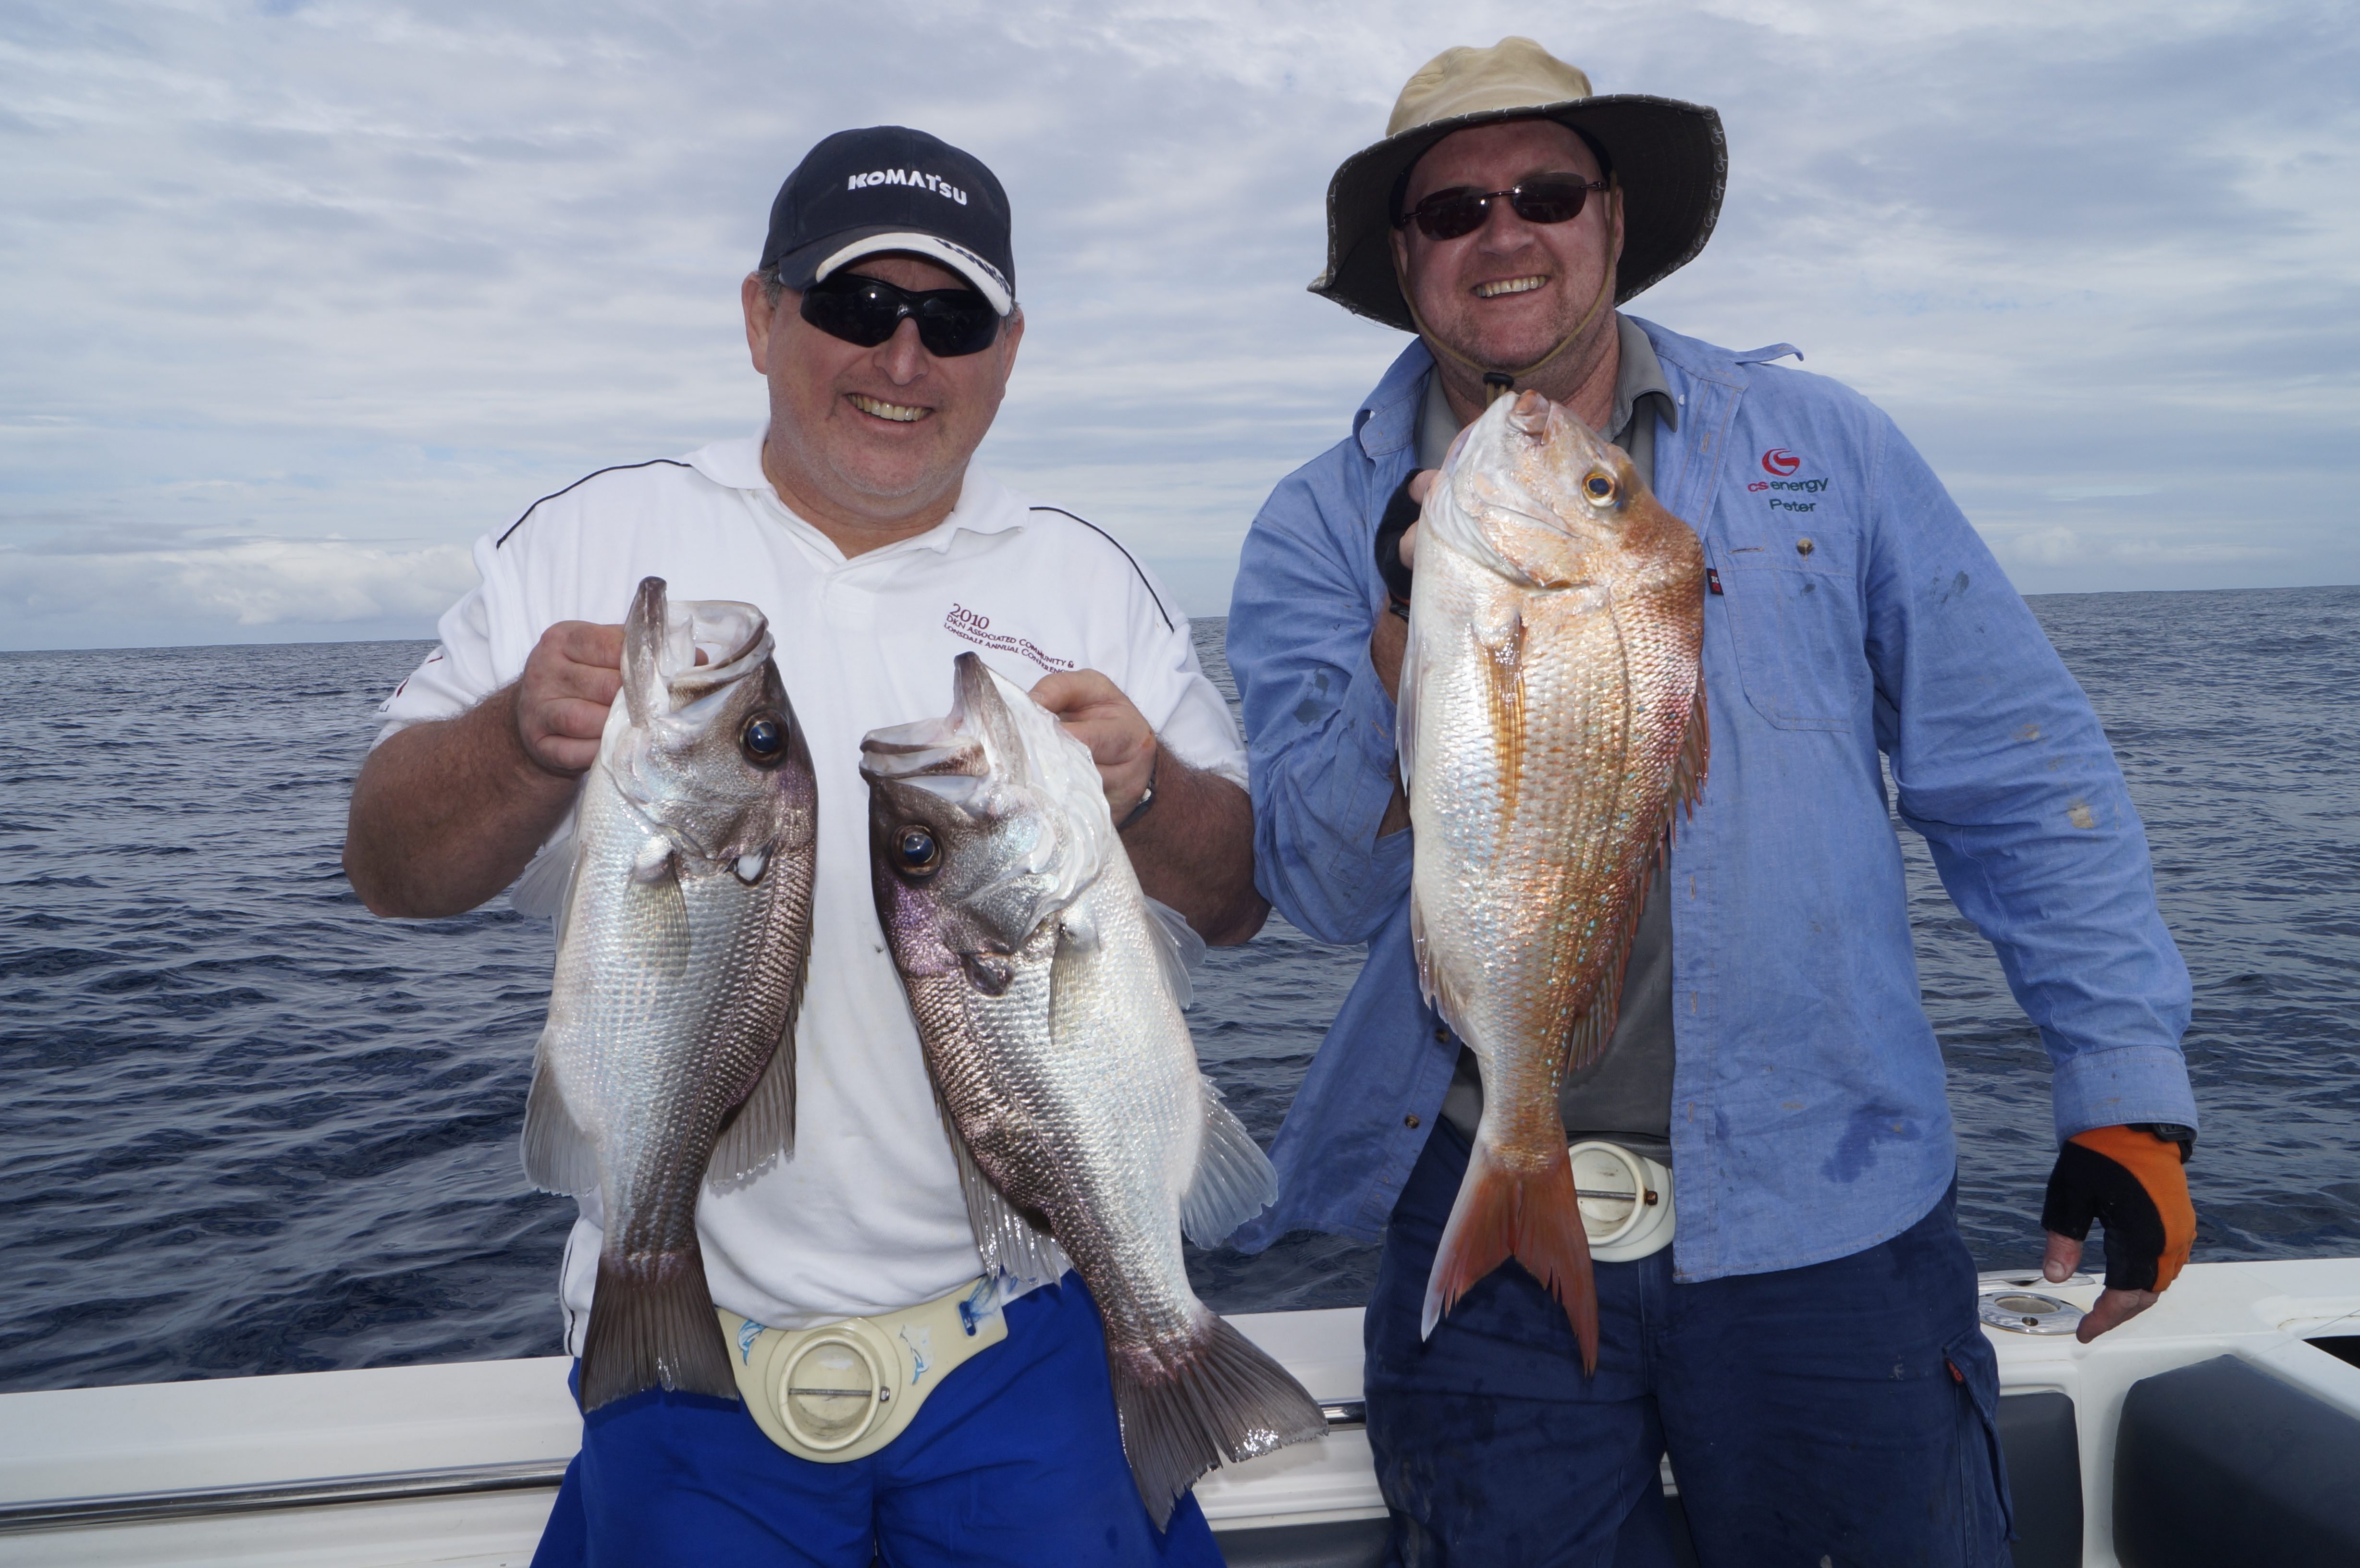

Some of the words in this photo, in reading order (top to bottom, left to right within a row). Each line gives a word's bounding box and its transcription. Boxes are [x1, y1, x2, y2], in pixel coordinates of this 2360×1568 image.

[848, 169, 967, 206] KOMATSU
[1770, 478, 1829, 493] energy
[1769, 499, 1817, 512] Peter
[949, 603, 990, 630] 2010
[944, 622, 983, 645] LONSDALE
[985, 641, 1019, 654] ANNUAL
[946, 614, 966, 629] DKN
[967, 626, 1017, 644] ASSOCIATED
[1019, 639, 1066, 666] COMMUNITY
